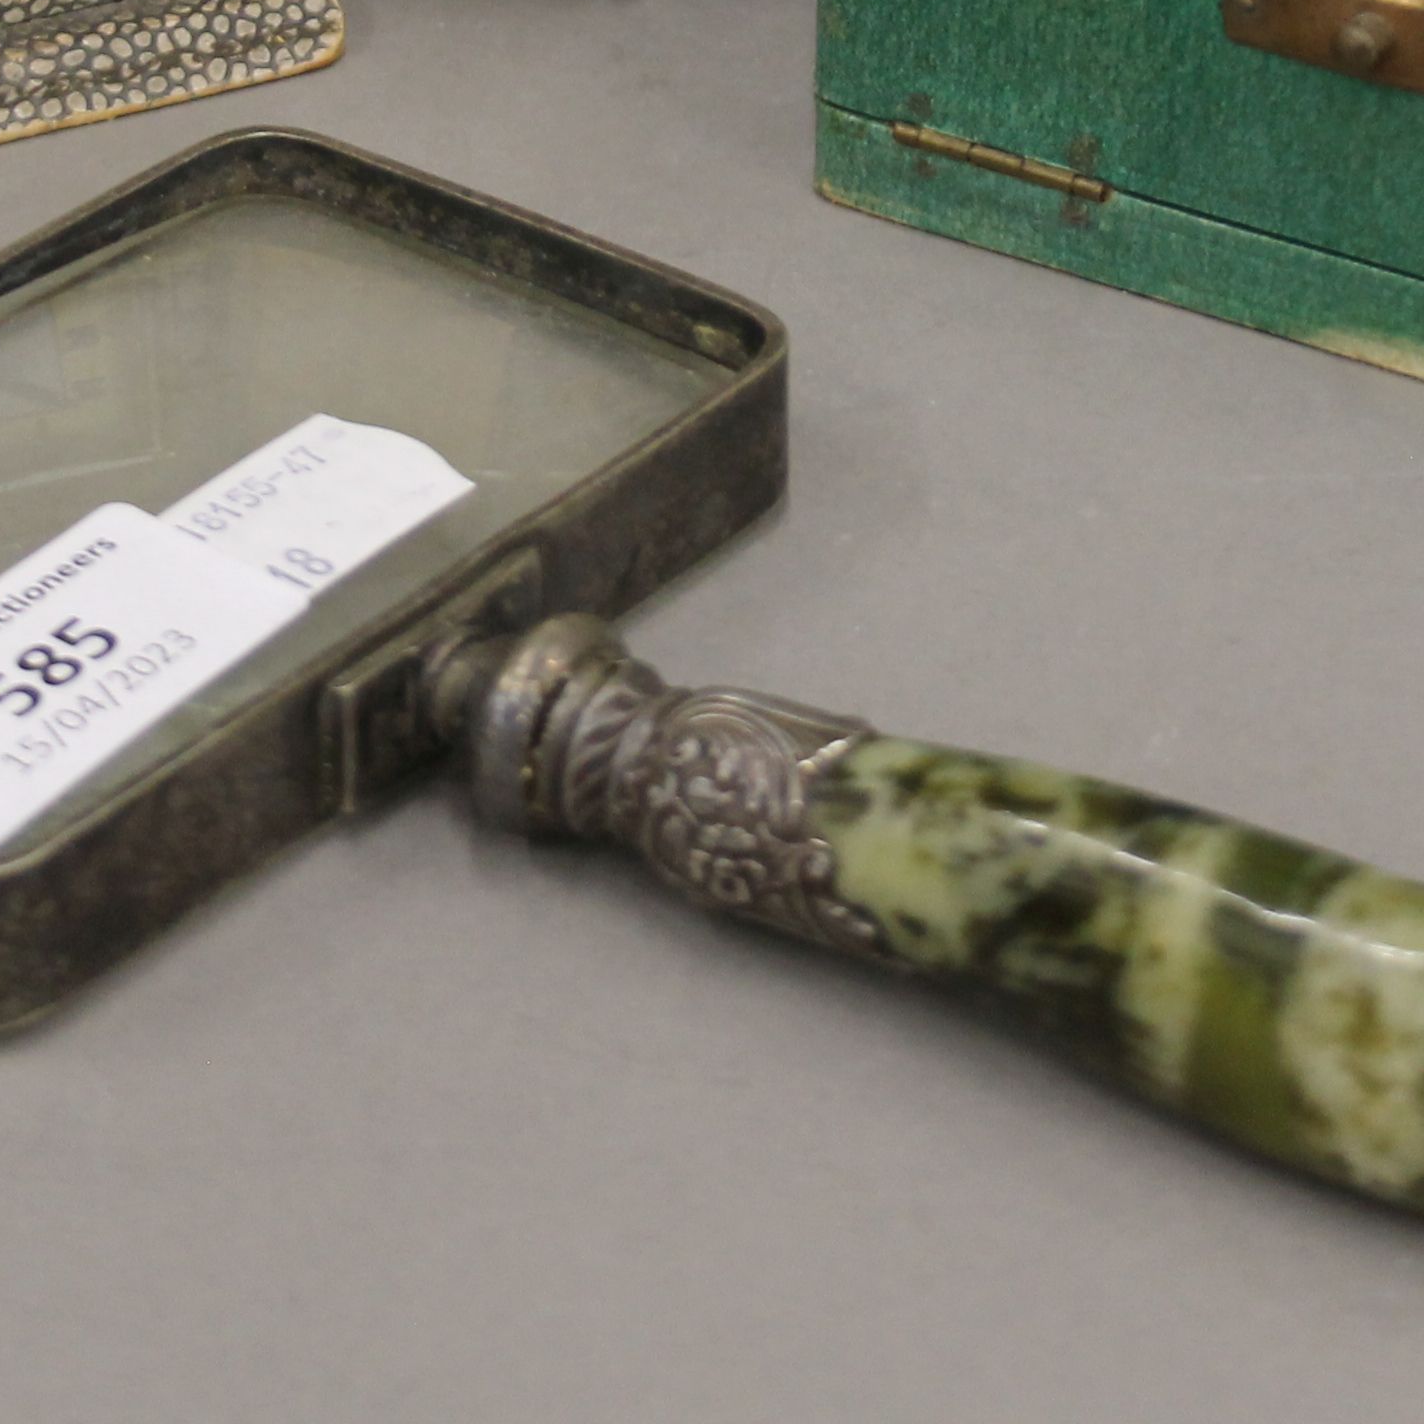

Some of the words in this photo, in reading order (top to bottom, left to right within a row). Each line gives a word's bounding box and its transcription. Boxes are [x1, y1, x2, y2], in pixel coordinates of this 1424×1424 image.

[176, 445, 327, 543] 18155-47
[266, 548, 335, 589] 18
[0, 628, 198, 774] 15/04/2023
